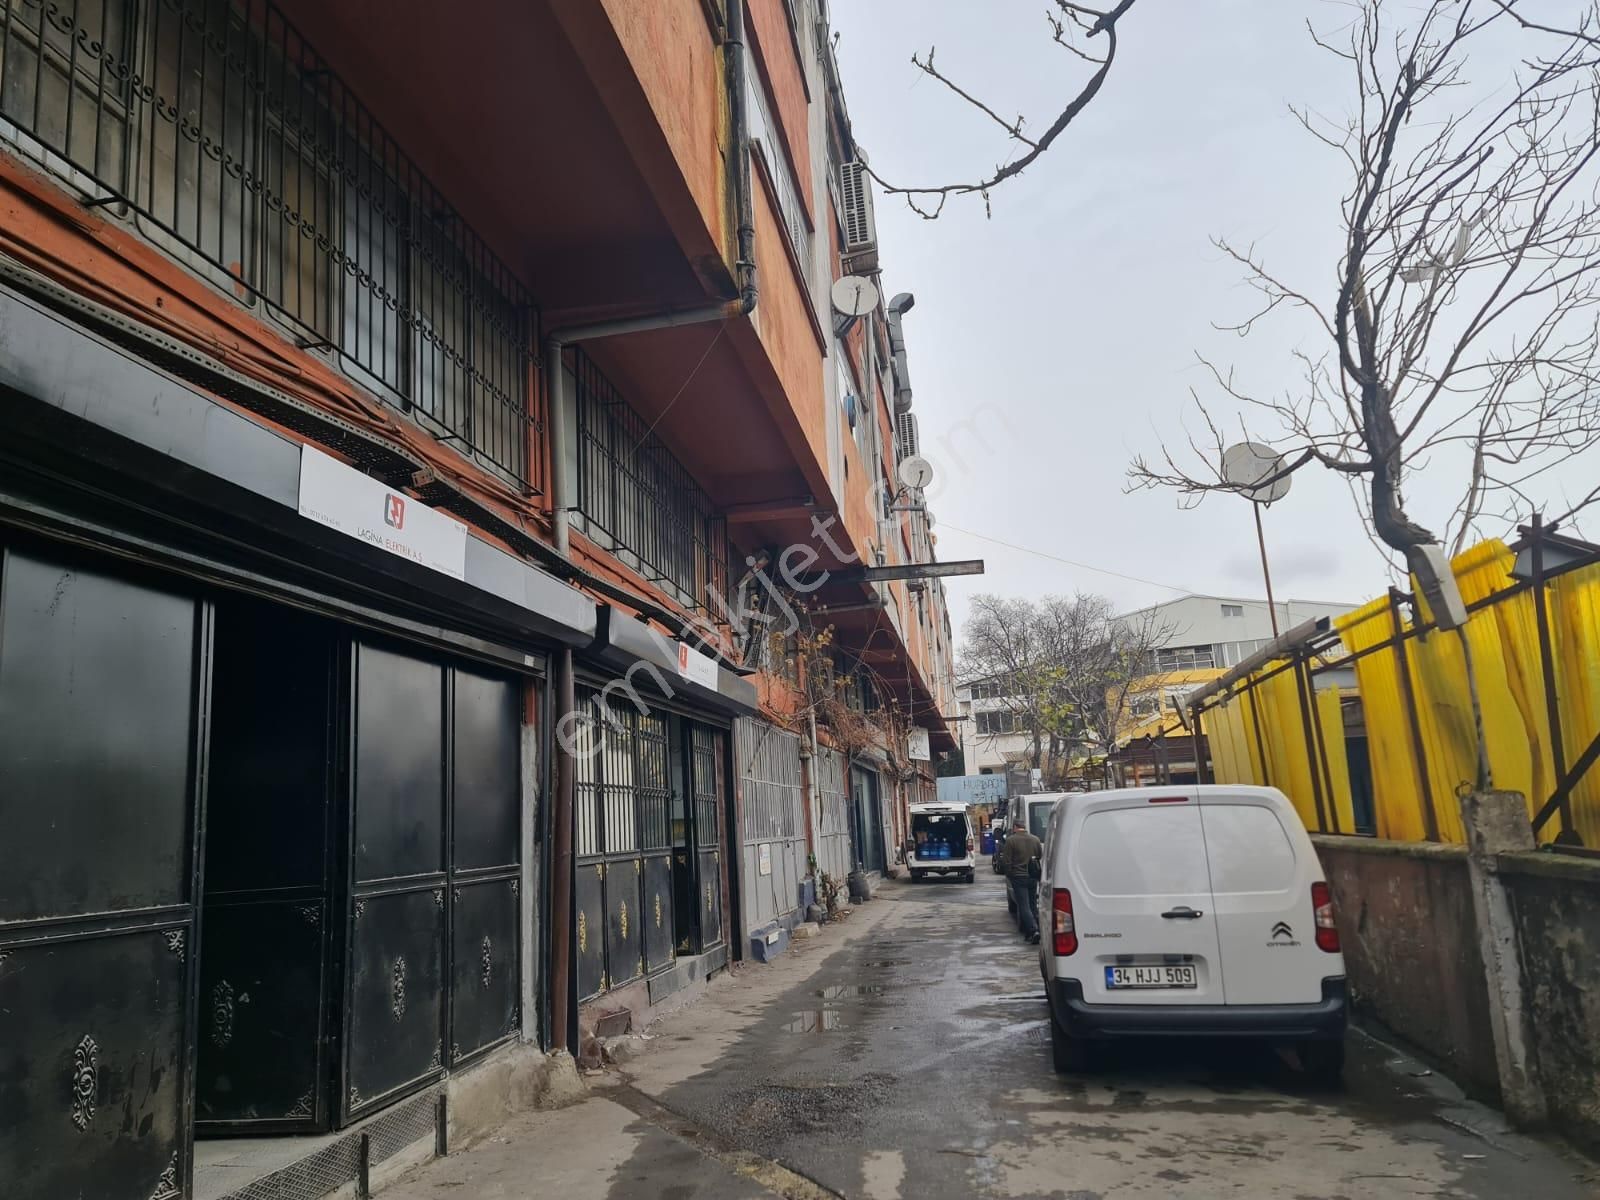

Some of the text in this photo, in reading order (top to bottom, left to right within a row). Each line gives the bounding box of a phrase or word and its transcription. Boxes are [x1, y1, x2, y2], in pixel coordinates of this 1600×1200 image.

[1114, 968, 1192, 984] 34 HJJ 509
